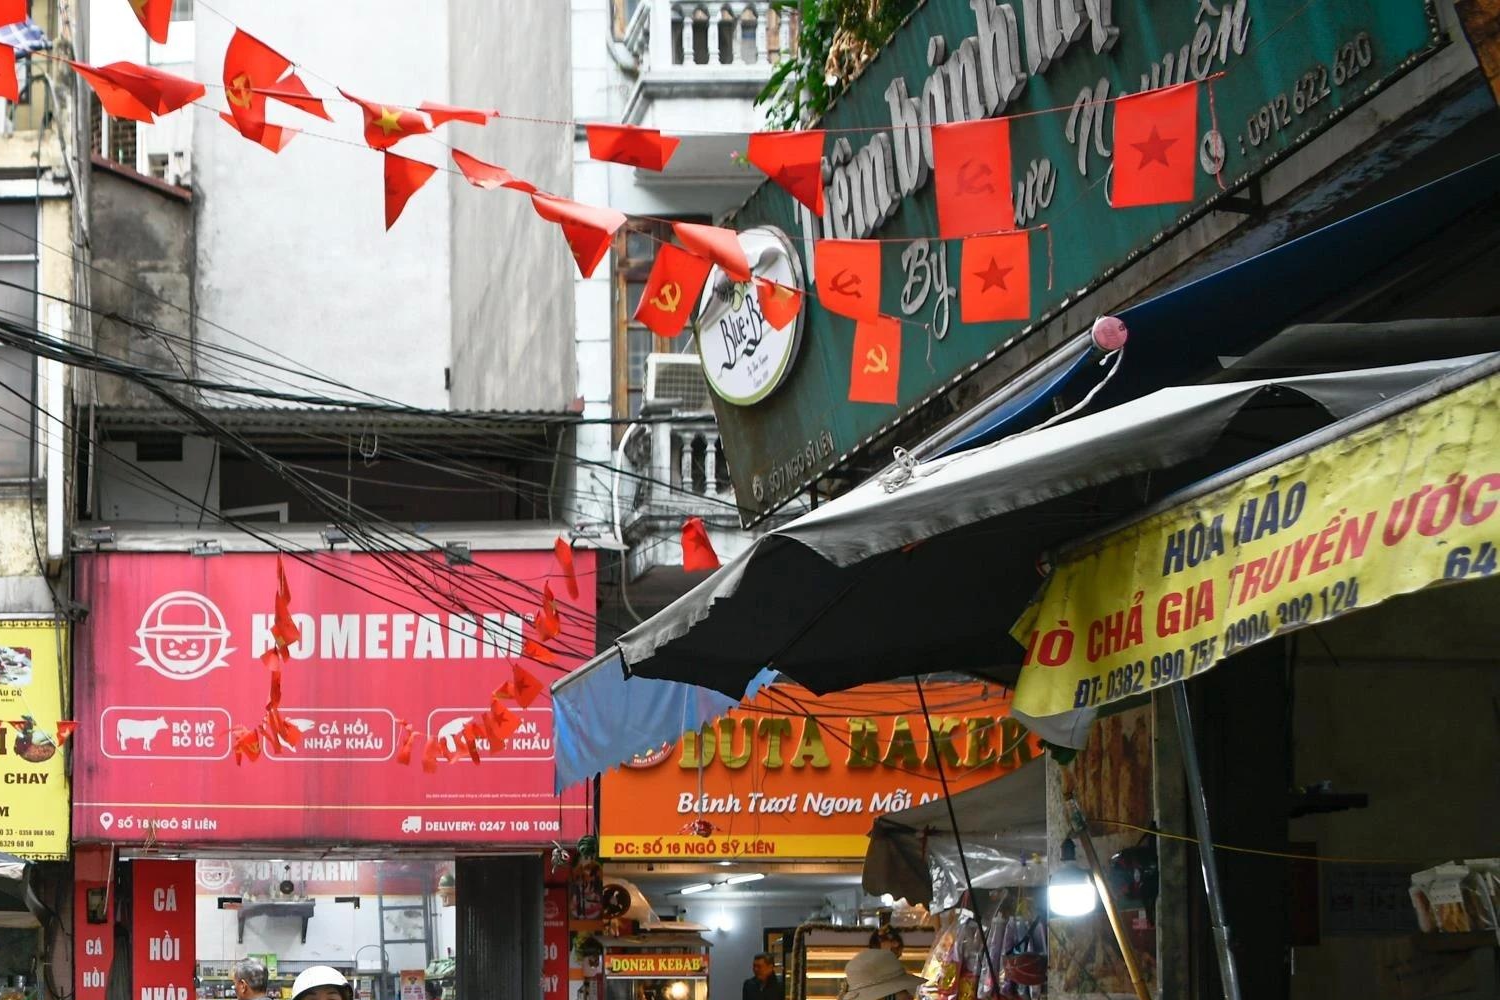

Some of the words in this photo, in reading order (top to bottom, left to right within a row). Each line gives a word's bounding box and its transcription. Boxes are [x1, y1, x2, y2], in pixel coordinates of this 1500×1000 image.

[1247, 93, 1292, 147] 0912
[1292, 65, 1331, 115] 622
[1331, 31, 1372, 86] 620
[900, 239, 956, 340] By
[1163, 511, 1225, 576] HÒA
[1234, 477, 1307, 546] HẢO
[1088, 591, 1142, 662] CHẢ
[1156, 581, 1213, 639] GIA
[1227, 508, 1378, 608] TRUYỀN
[1107, 661, 1144, 700] 0382
[1150, 650, 1183, 686] 990
[1320, 578, 1358, 619] 124
[172, 719, 191, 733] BÒ
[195, 720, 215, 733] MỸ
[344, 718, 368, 735] HỒI
[172, 733, 191, 747] BÒ
[304, 738, 342, 752] NHẬP
[679, 717, 831, 769] DUTA
[4, 773, 49, 784] CHAY
[677, 792, 740, 813] Bánh
[748, 793, 797, 813] Tươi
[803, 793, 861, 816] Ngon
[117, 815, 133, 829] SỐ
[137, 819, 149, 829] 18
[153, 817, 178, 829] NGÔ
[194, 817, 217, 829] LIÊN
[425, 821, 476, 831] DELIVERY:
[479, 821, 506, 831] 0247
[510, 821, 529, 831] 108
[533, 821, 559, 831] 1008
[614, 843, 639, 855] ĐC:
[643, 837, 663, 855] SỐ
[667, 842, 680, 855] 16
[744, 841, 775, 855] LIÊN
[153, 885, 177, 911] CÁ
[85, 937, 102, 955] CÁ
[149, 930, 180, 960] HỒI
[611, 957, 656, 972] DONER
[658, 958, 701, 971] KEBAB
[83, 968, 104, 987] HỒI
